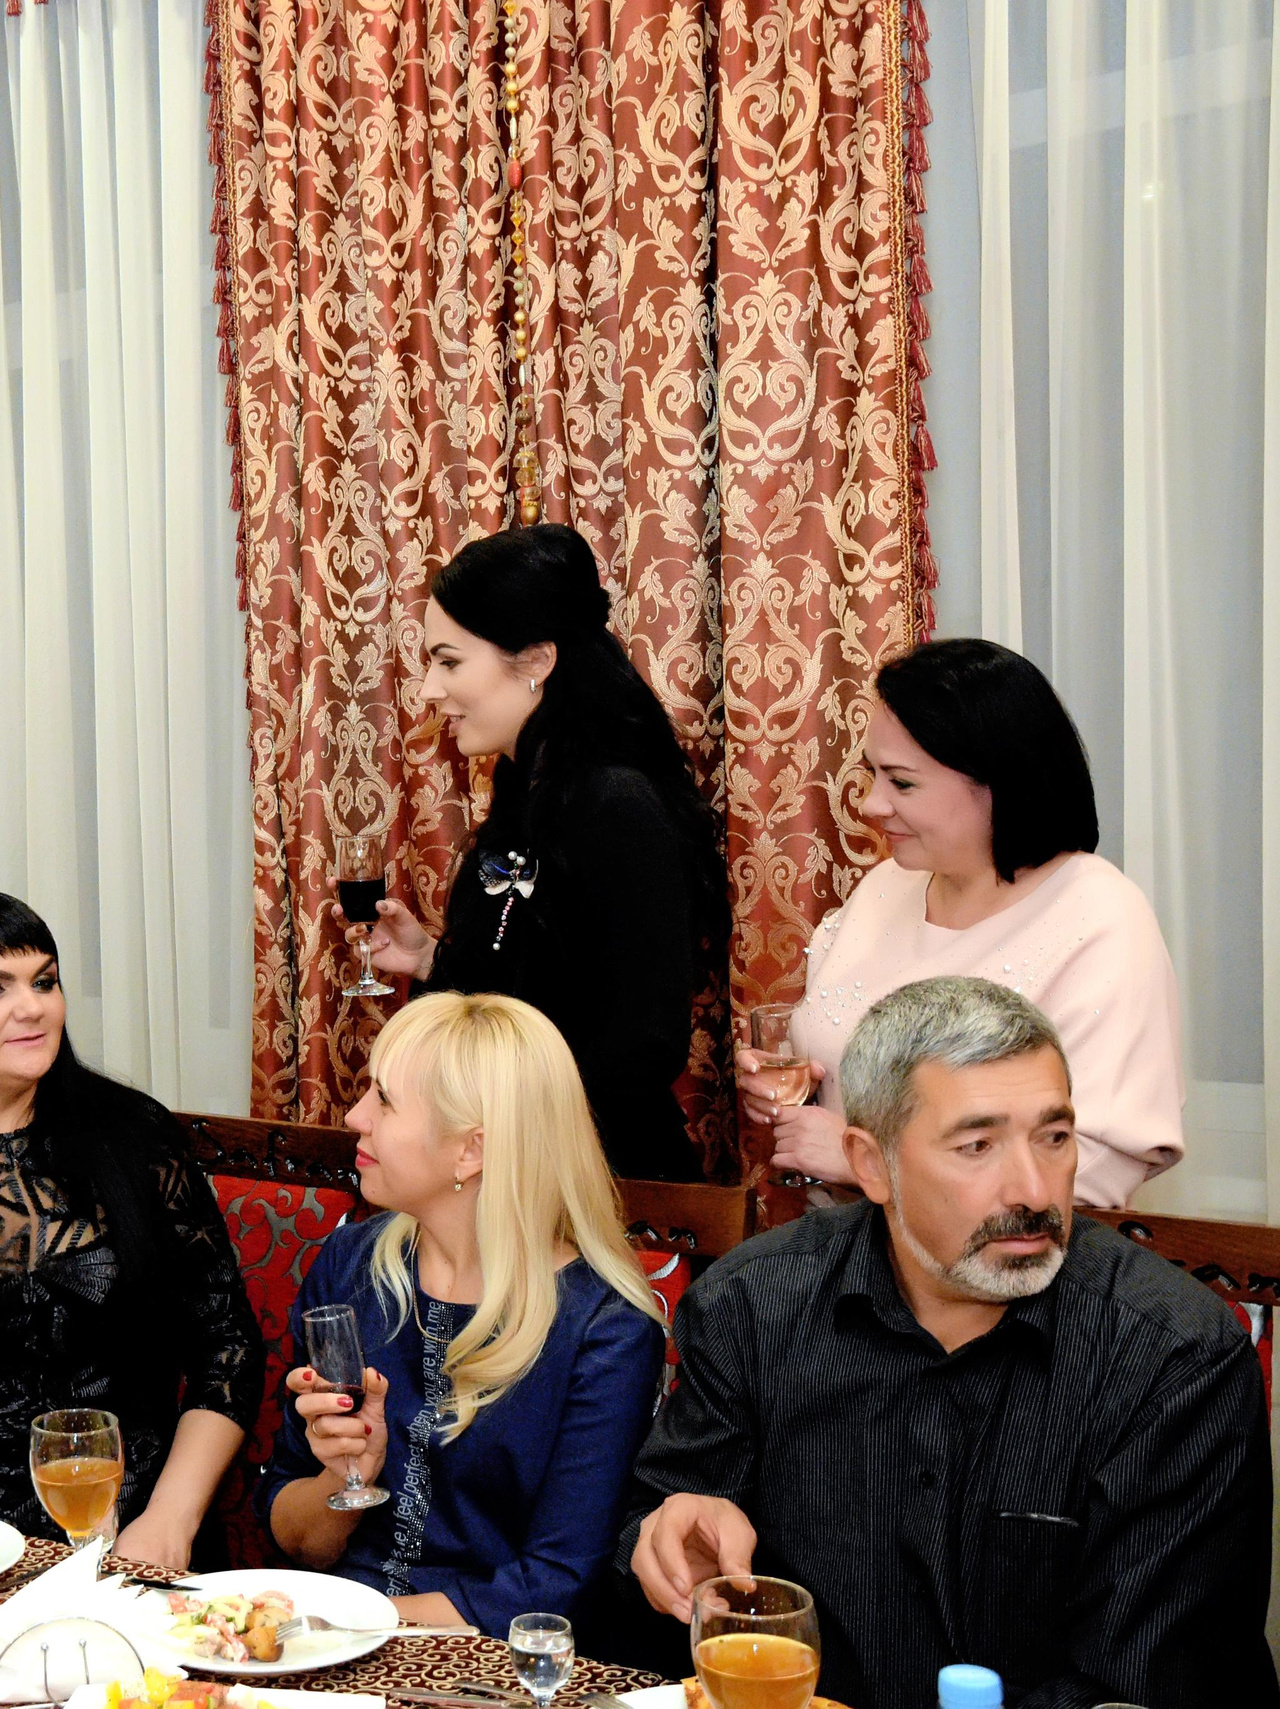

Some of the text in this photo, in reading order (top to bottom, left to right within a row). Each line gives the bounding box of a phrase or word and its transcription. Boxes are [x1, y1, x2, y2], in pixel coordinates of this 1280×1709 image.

[427, 1301, 441, 1324] me
[423, 1356, 437, 1380] are
[423, 1379, 437, 1407] you
[406, 1409, 432, 1443] when
[403, 1443, 421, 1494] perfect
[393, 1491, 415, 1521] feel
